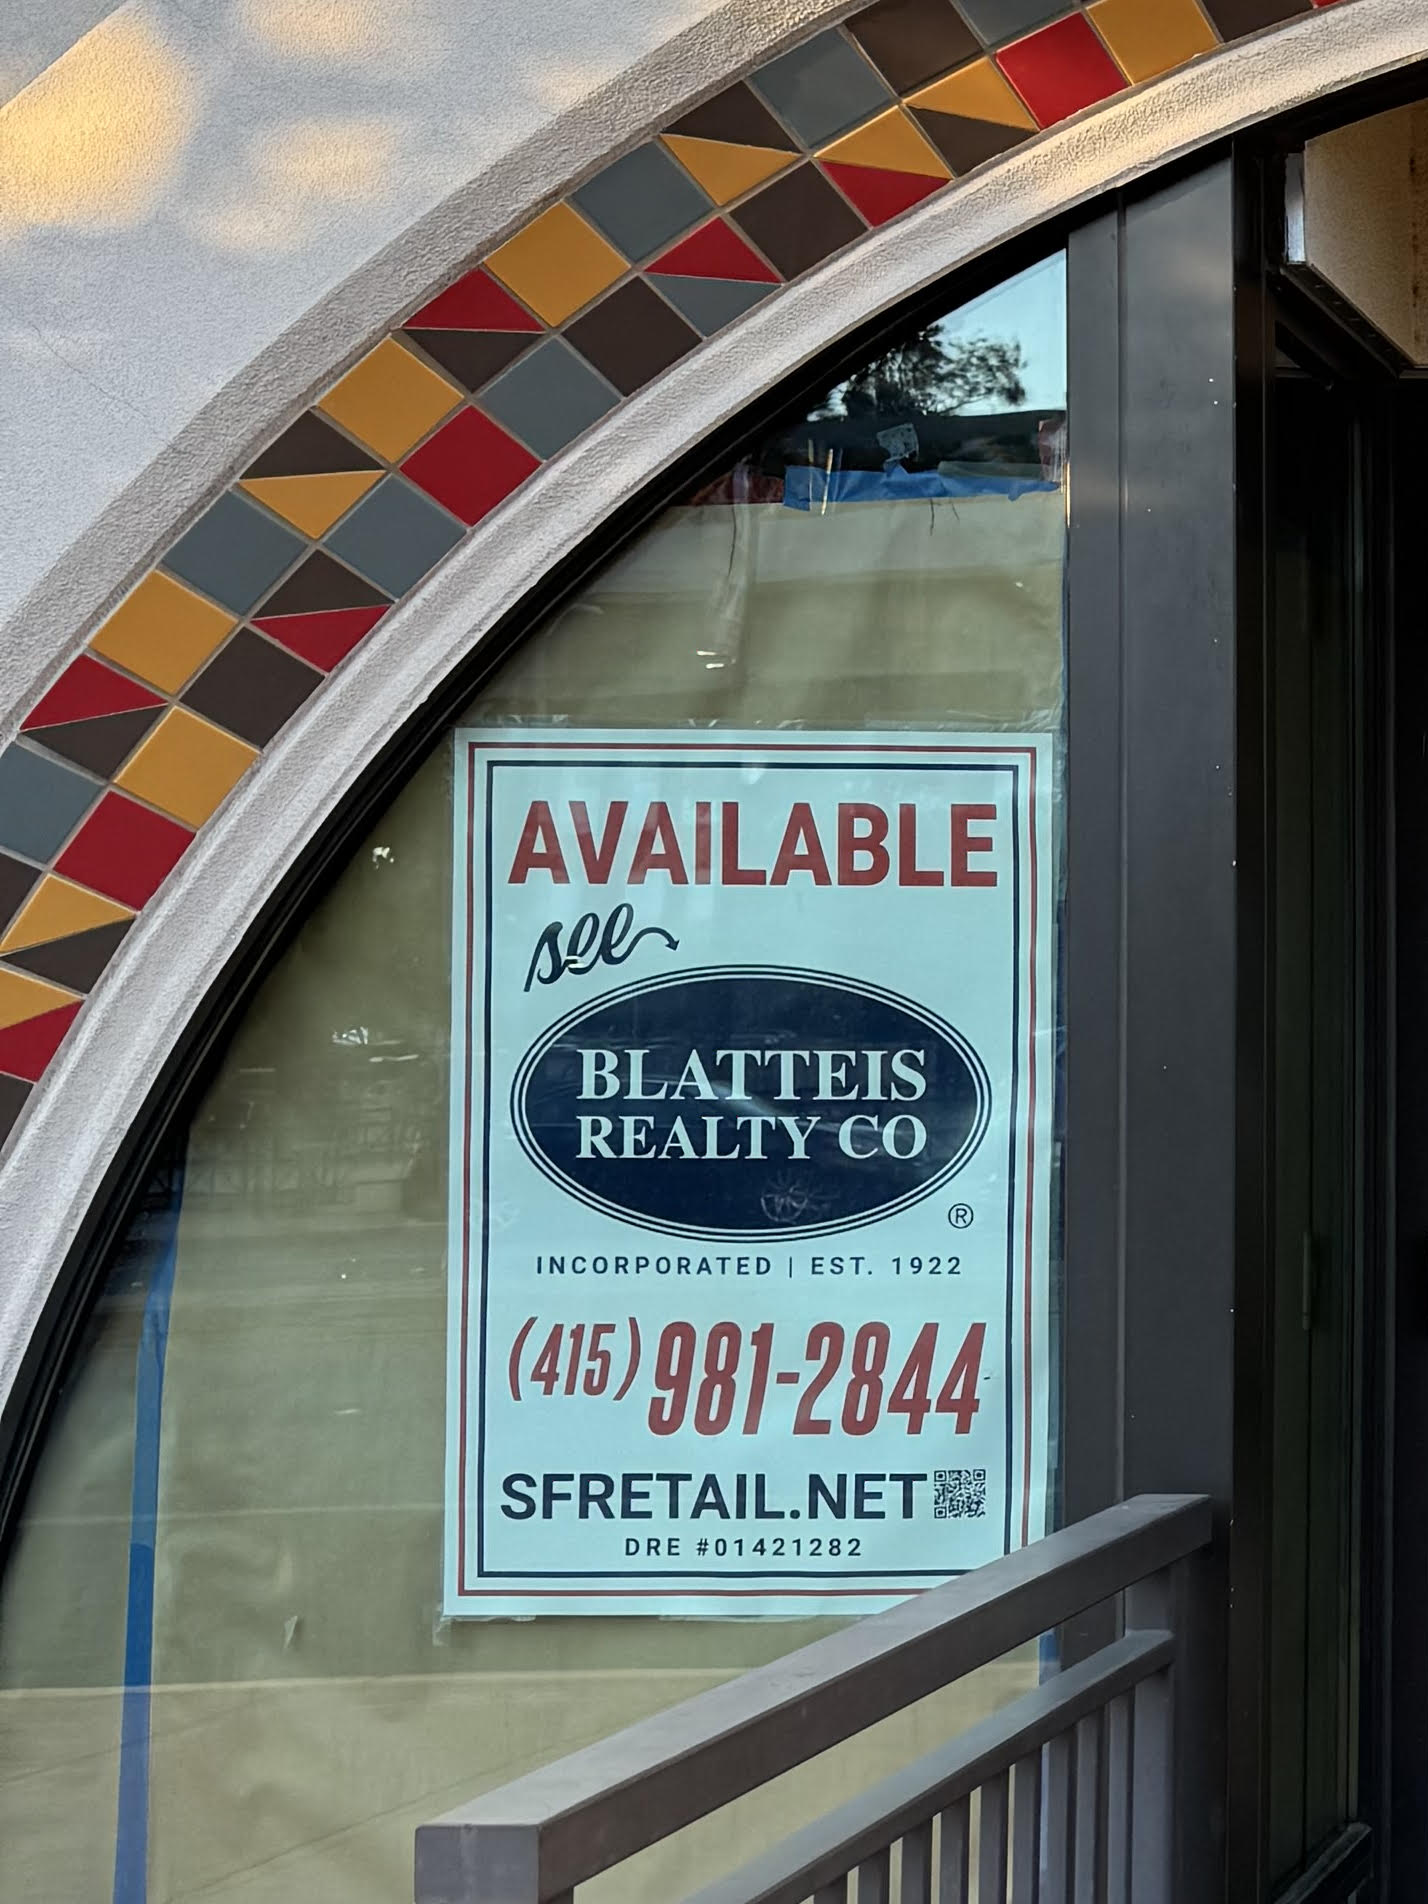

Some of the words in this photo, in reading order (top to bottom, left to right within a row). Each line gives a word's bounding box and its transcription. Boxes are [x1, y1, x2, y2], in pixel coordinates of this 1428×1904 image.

[507, 799, 998, 888] AVAILABLE
[523, 903, 640, 993] see
[576, 1048, 927, 1105] BLATTEIS
[575, 1115, 822, 1160] REALTY
[838, 1114, 927, 1160] CO
[536, 1256, 772, 1276] INCORPORATED
[811, 1256, 874, 1276] EST.
[892, 1256, 962, 1276] 1922
[507, 1316, 642, 1403] (415)
[647, 1320, 987, 1438] 981-2844
[500, 1472, 928, 1520] SFRETAIL.NET
[625, 1537, 680, 1557] DRE
[696, 1537, 862, 1557] #01421282
